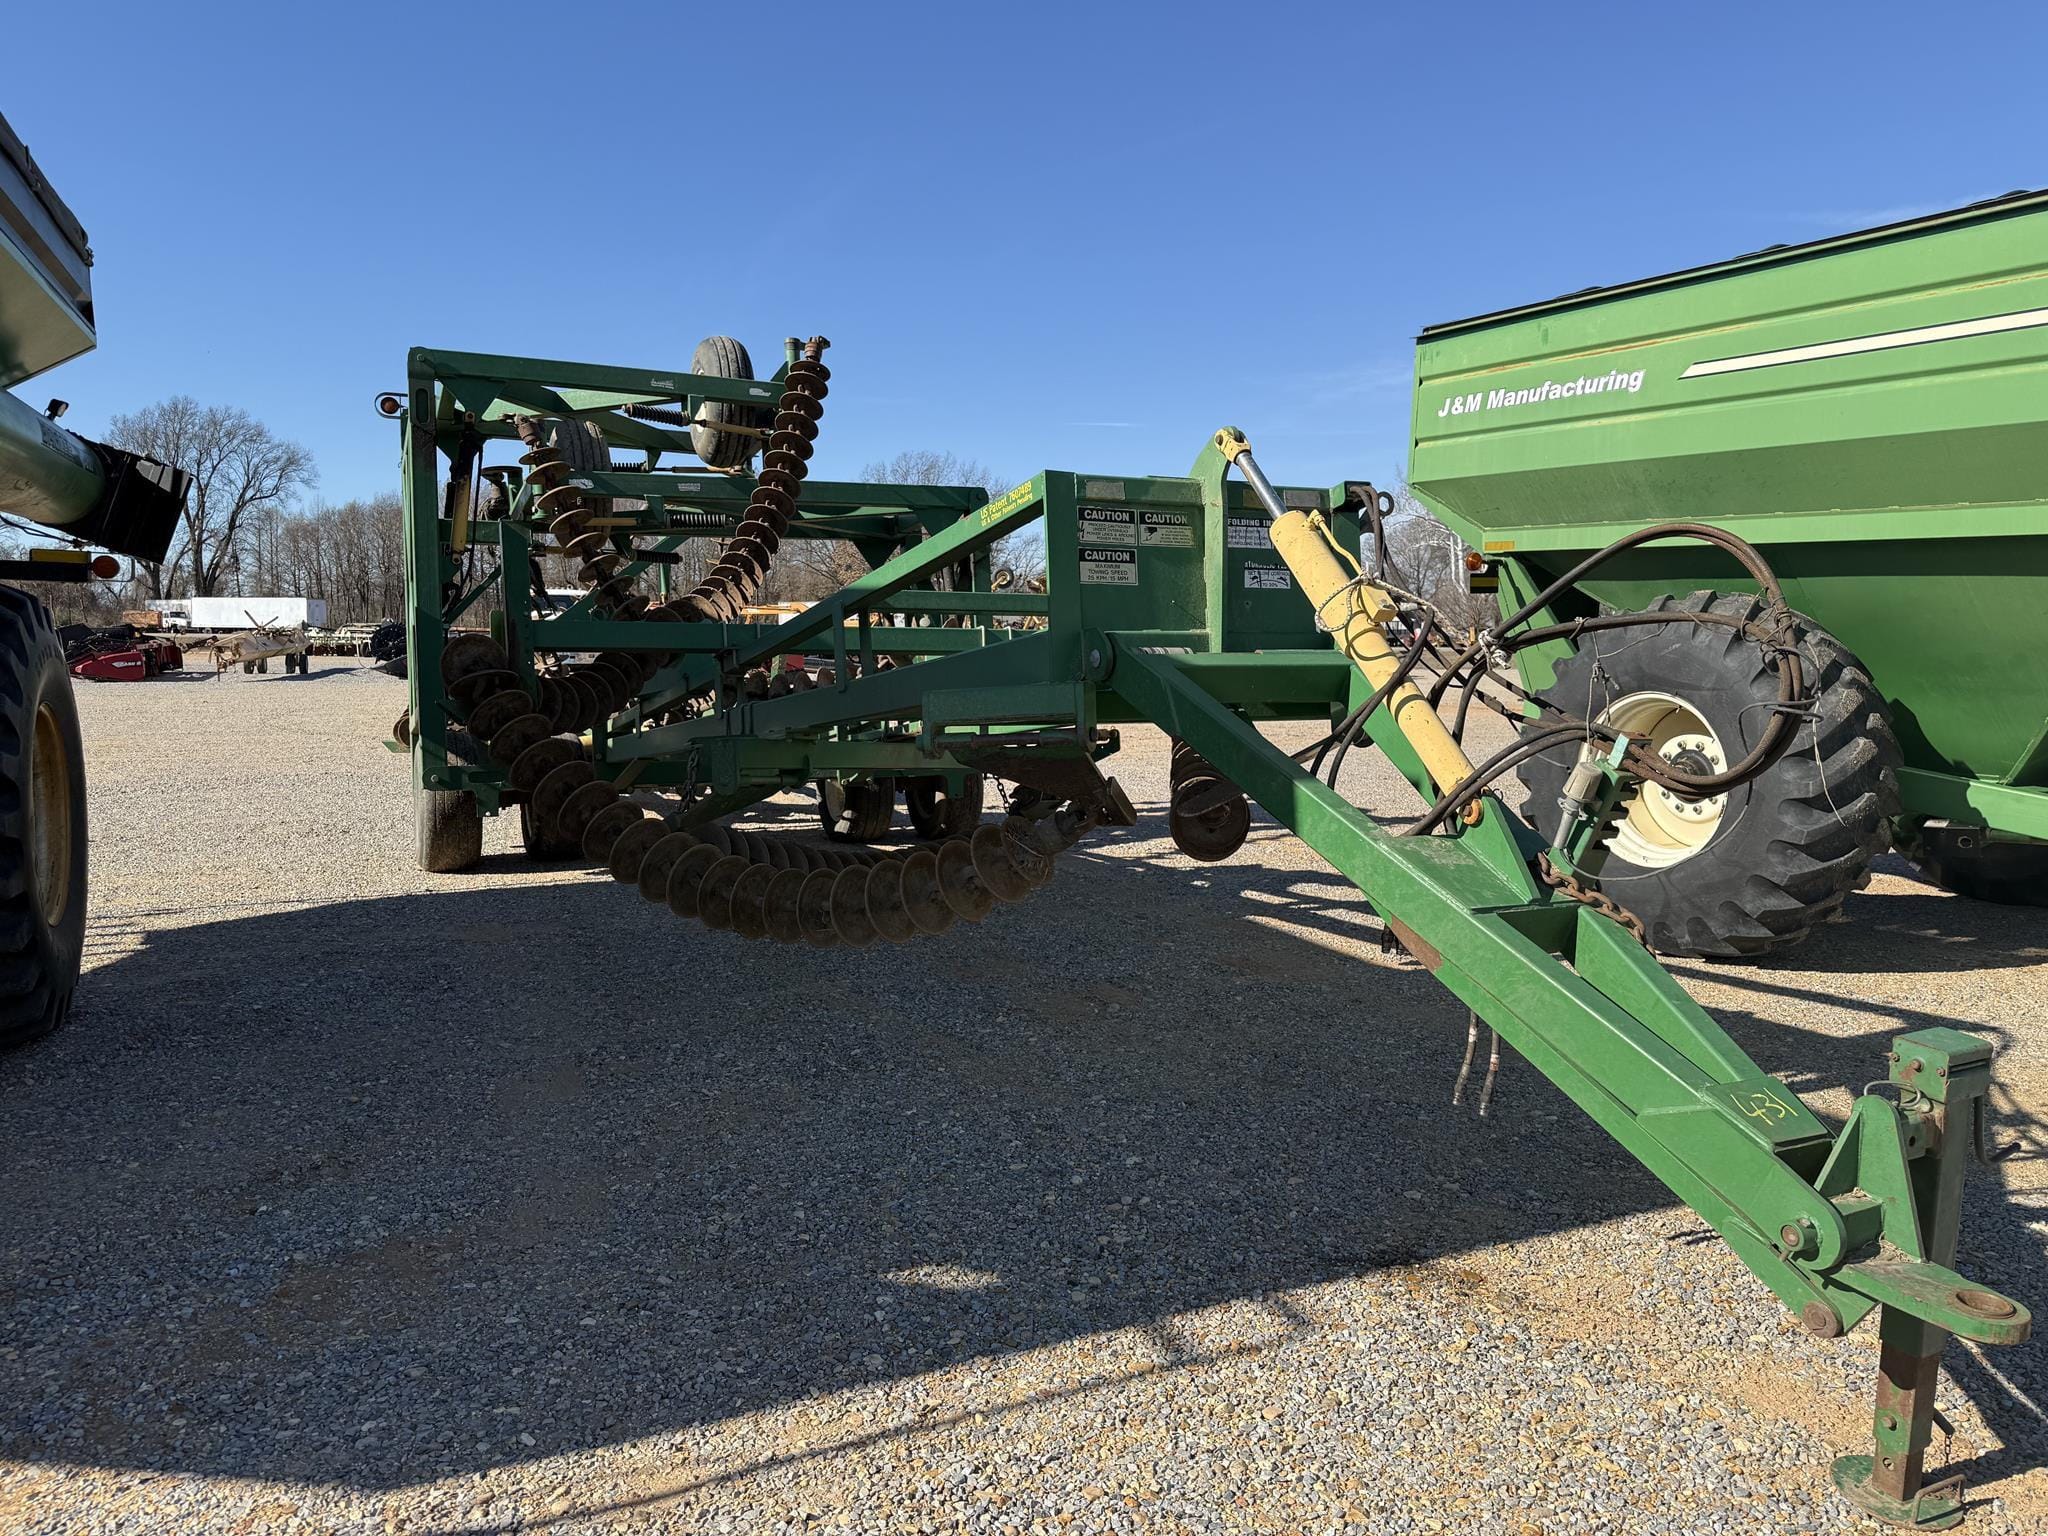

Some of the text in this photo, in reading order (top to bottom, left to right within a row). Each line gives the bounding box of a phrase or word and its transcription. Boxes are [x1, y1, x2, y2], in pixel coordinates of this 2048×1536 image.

[1437, 368, 1647, 417] J&M Manufacturing
[989, 496, 1007, 514] Patent
[1084, 509, 1130, 522] CAUTION
[1144, 513, 1188, 524] CAUTION
[1227, 518, 1260, 527] FOLDING
[1084, 550, 1130, 562] CAUTION
